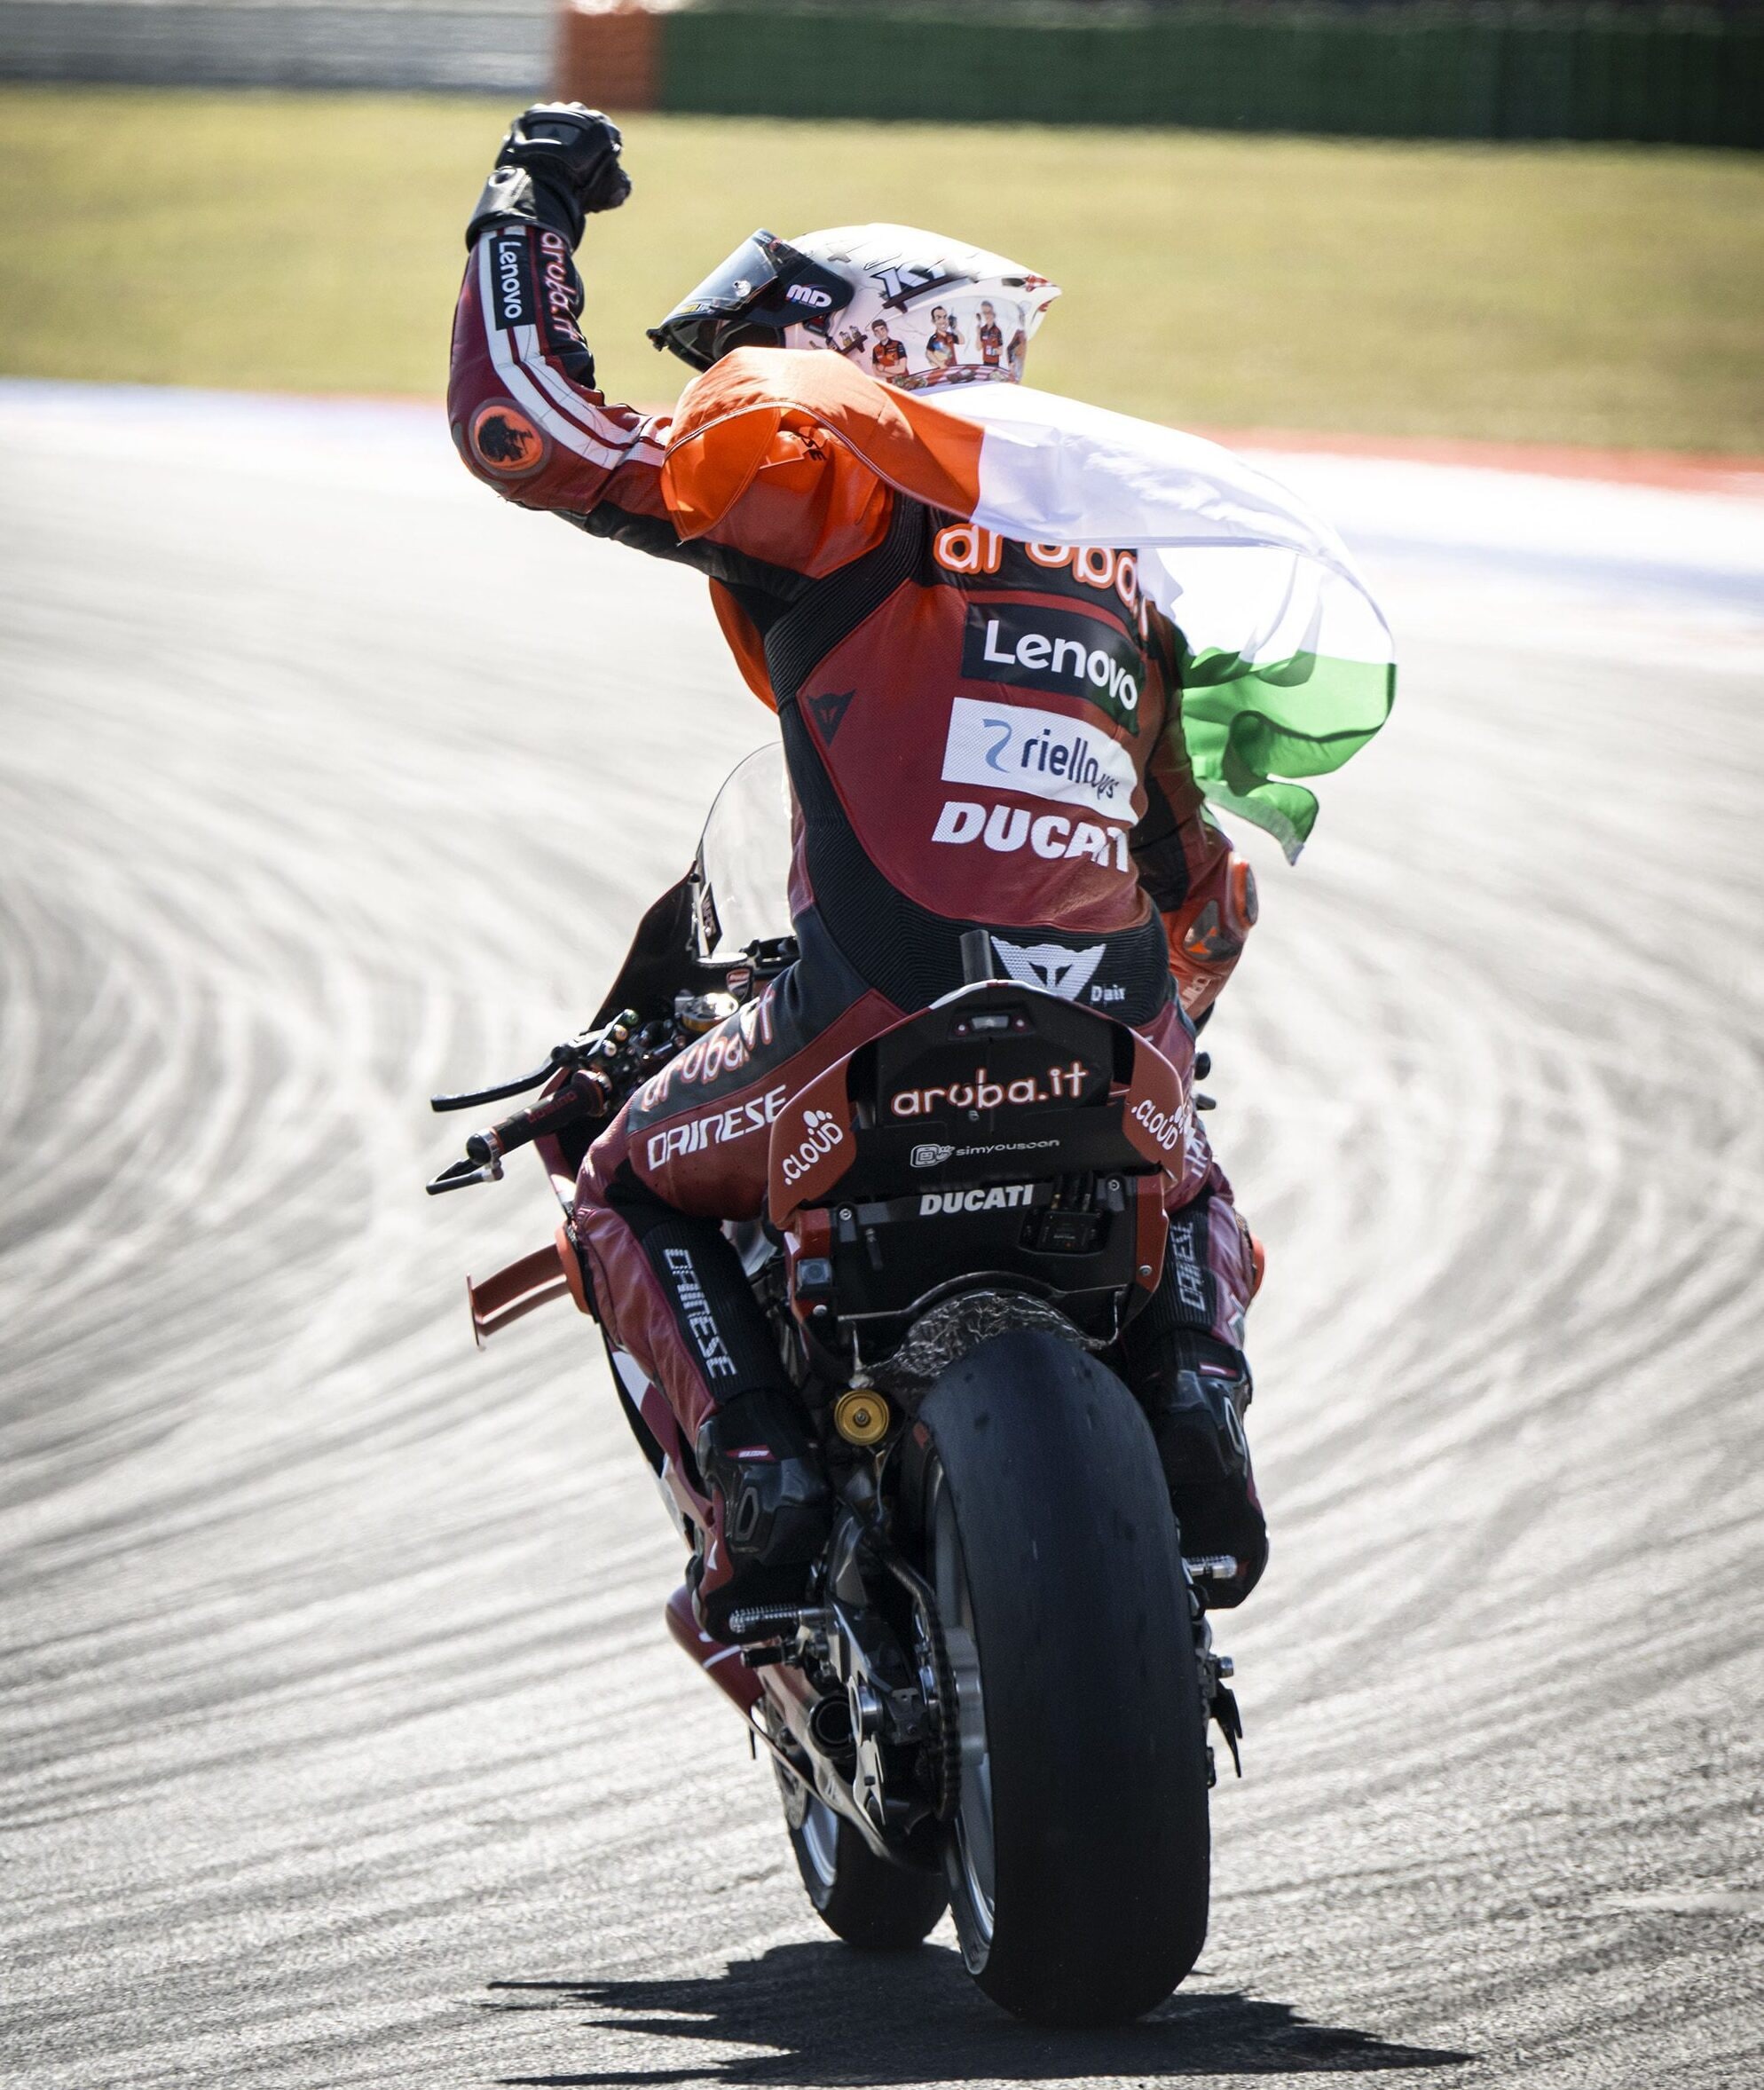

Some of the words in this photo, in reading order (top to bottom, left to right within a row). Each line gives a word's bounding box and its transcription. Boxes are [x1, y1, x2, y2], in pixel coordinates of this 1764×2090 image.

[498, 241, 522, 319] Lenovo
[983, 619, 1138, 710] Lenovo
[647, 1084, 787, 1171] DAINESE
[890, 1061, 1089, 1117] aruba.it
[918, 1183, 1035, 1217] DUCATI
[663, 1247, 737, 1379] DAINESE
